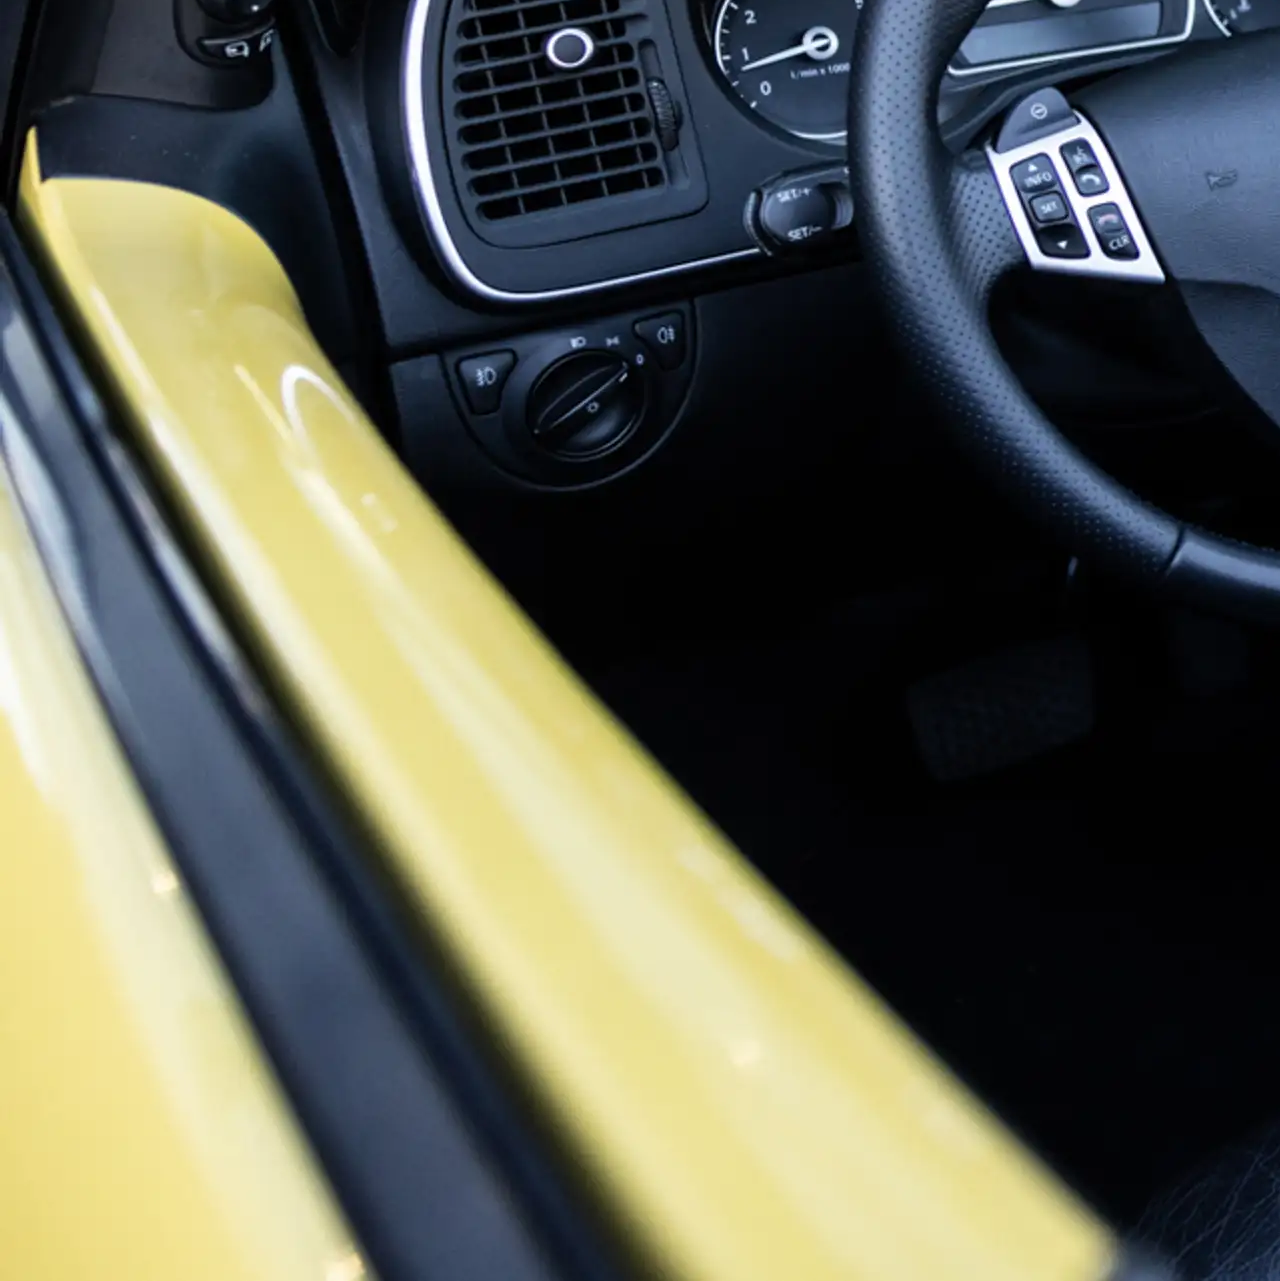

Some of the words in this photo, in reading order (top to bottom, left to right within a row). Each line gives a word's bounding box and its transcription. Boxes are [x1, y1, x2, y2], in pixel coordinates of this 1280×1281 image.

[745, 10, 757, 24] 2
[741, 47, 749, 61] 1
[760, 81, 772, 96] 0
[1023, 172, 1053, 187] INFO
[1040, 202, 1058, 214] SET
[1109, 235, 1130, 250] CLR
